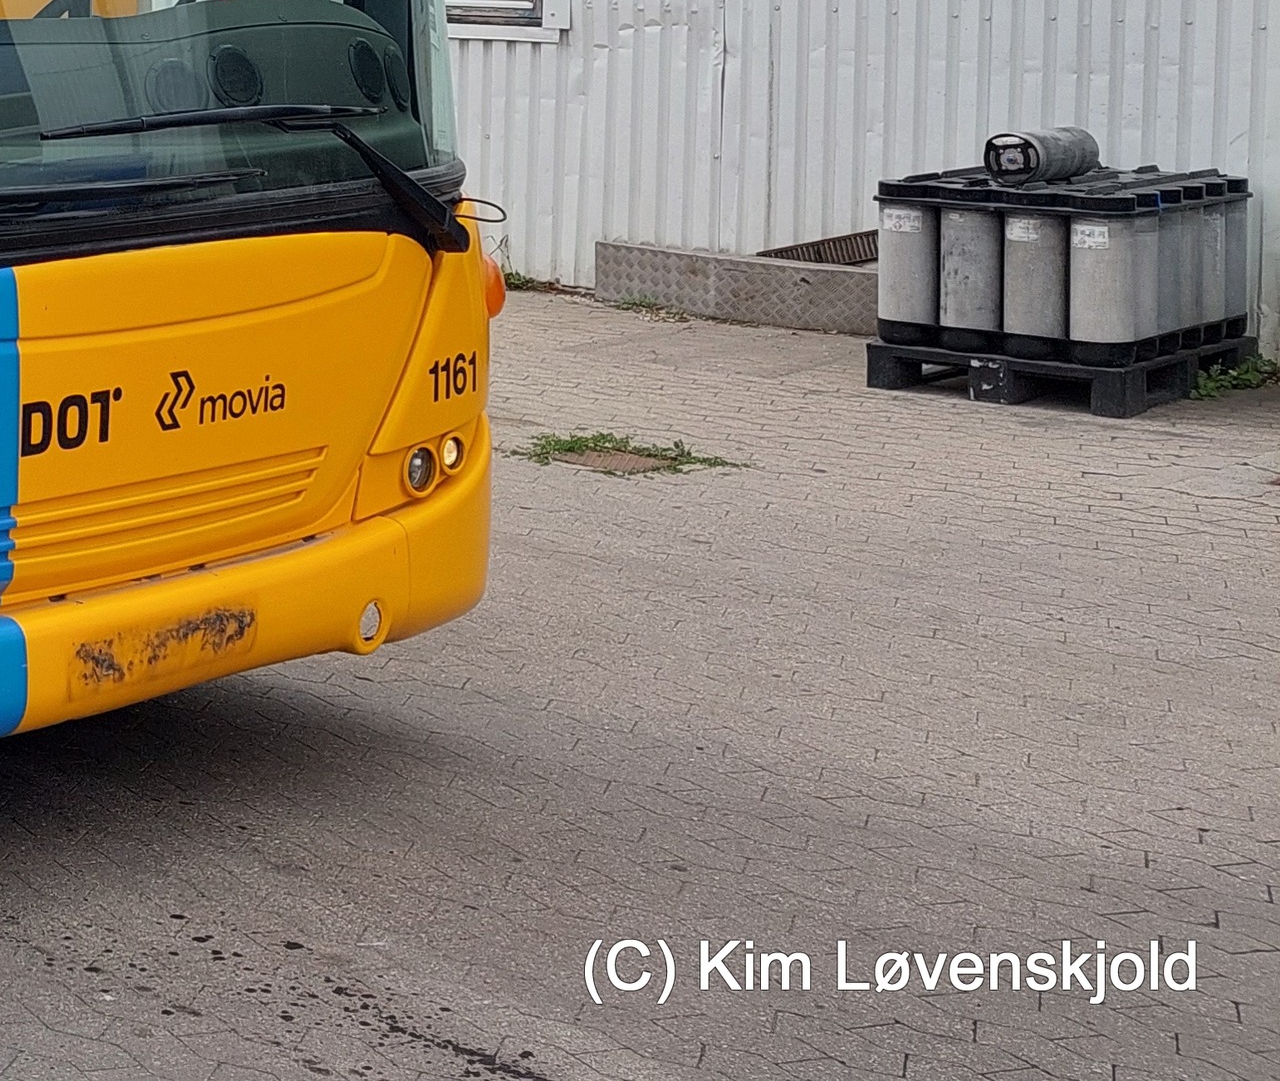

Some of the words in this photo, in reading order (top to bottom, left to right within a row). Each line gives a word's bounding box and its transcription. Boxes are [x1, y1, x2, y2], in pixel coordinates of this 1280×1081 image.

[428, 350, 478, 404] 1161
[19, 387, 118, 458] DOT
[197, 374, 287, 426] movia
